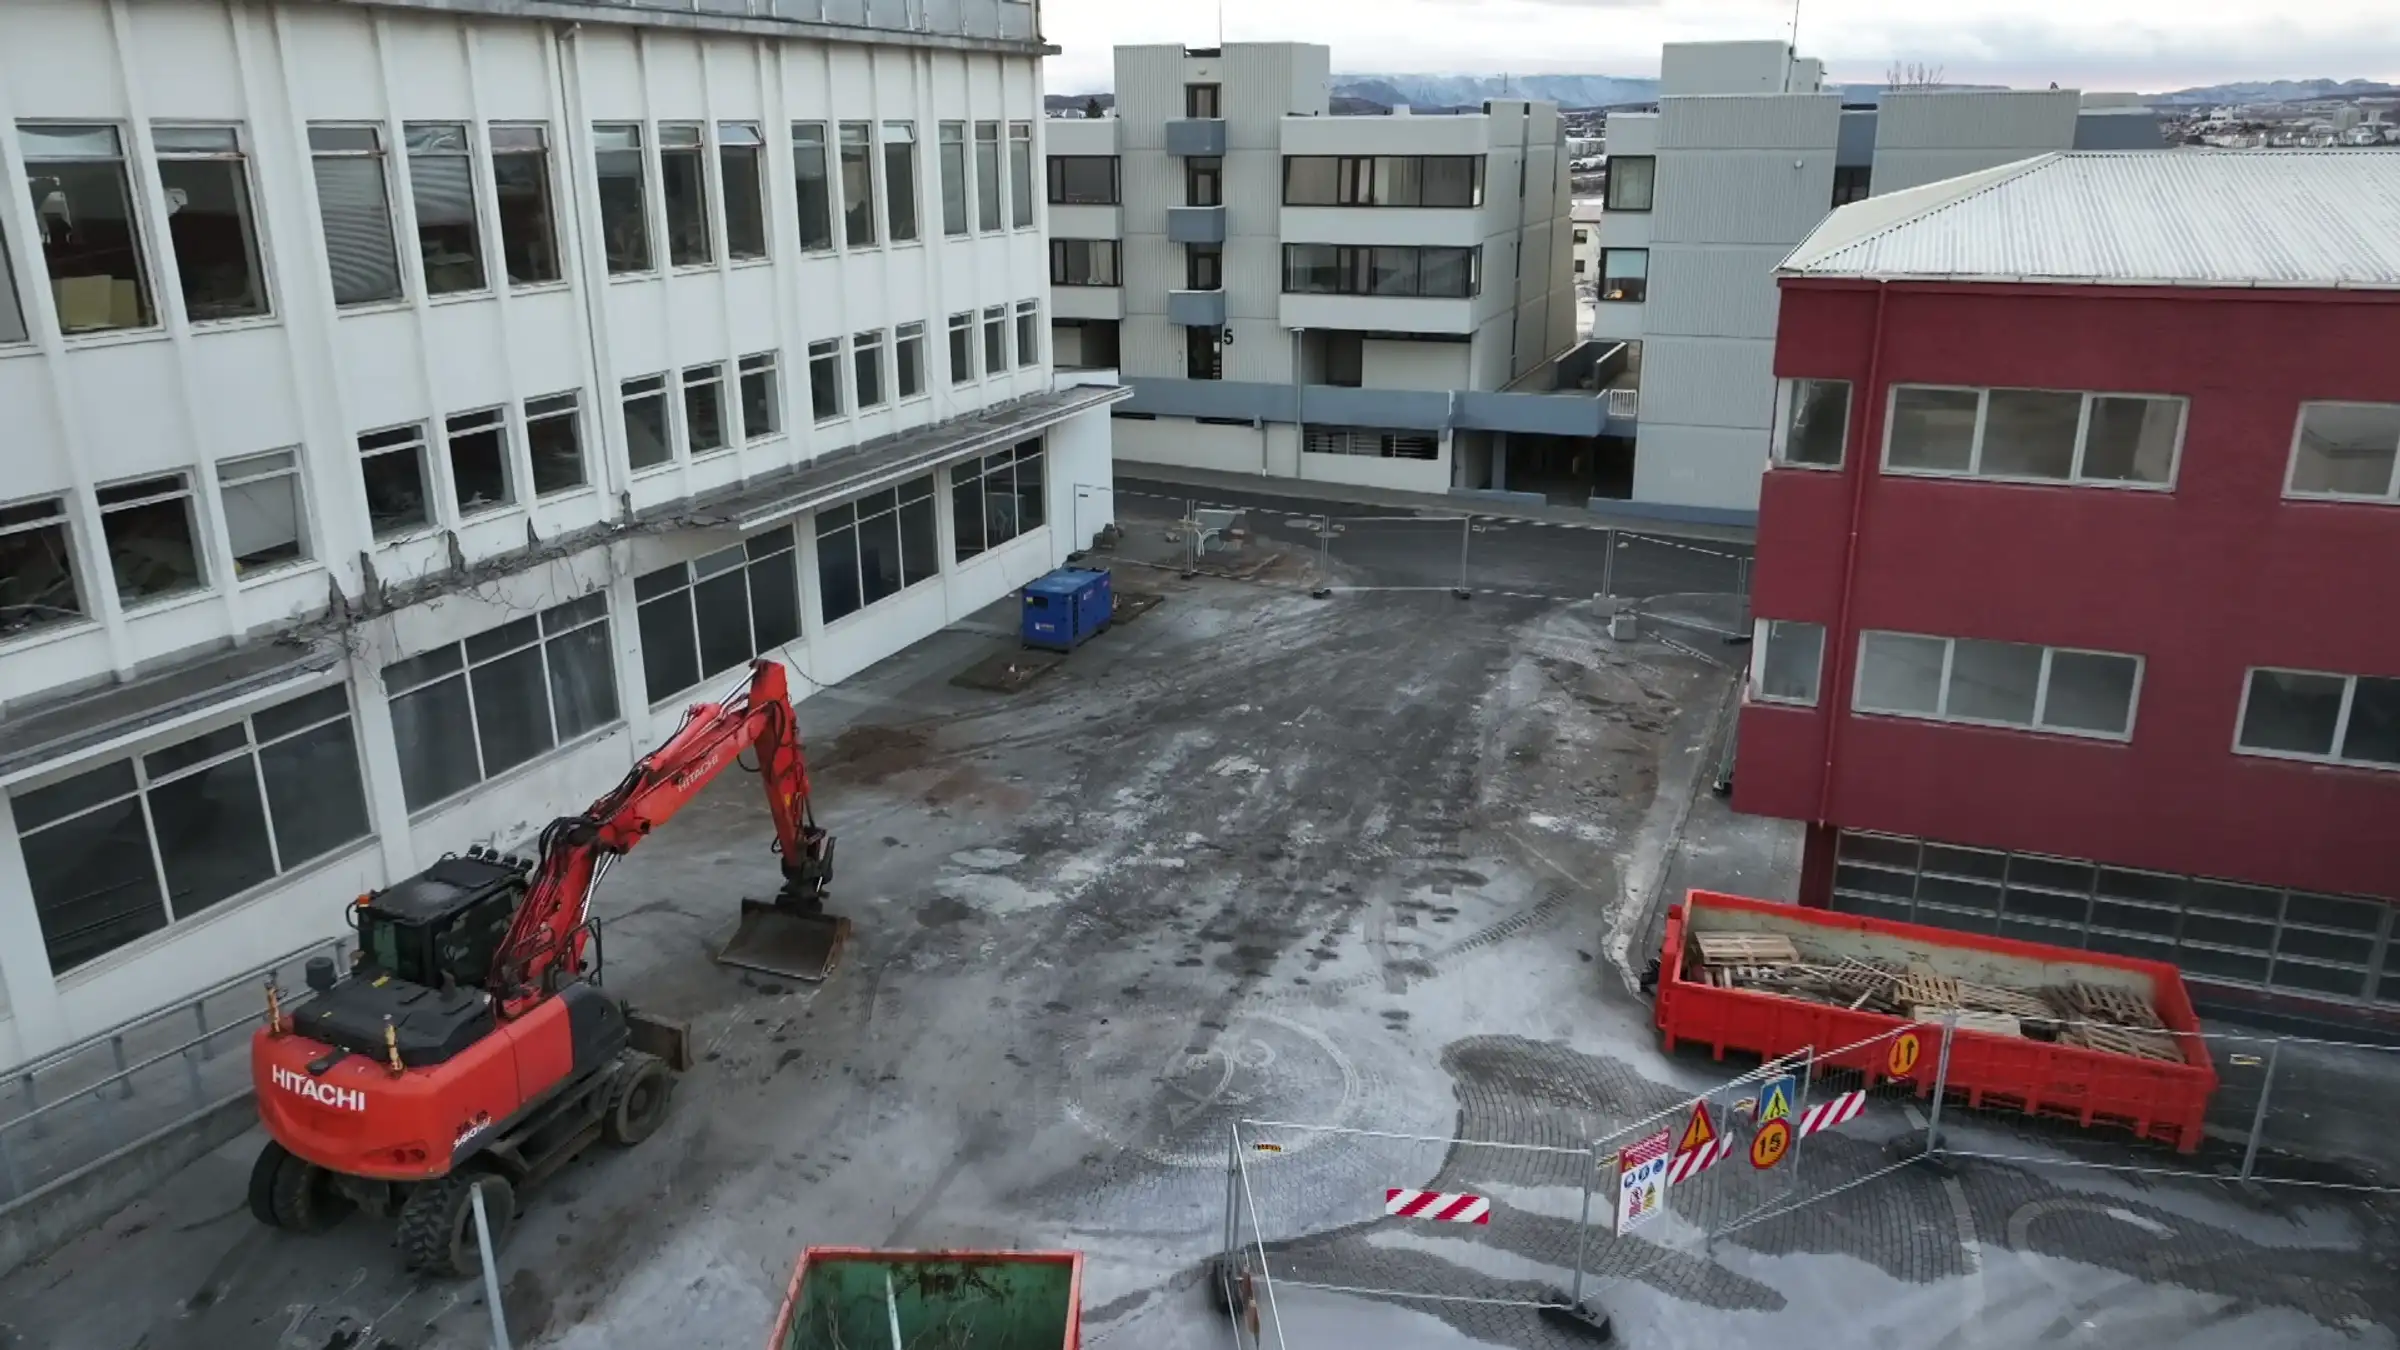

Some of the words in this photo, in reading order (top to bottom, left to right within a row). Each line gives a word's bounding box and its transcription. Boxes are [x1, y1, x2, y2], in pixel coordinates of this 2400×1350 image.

[1223, 328, 1234, 345] 5
[677, 754, 719, 792] HITACHI
[272, 1064, 365, 1112] HITACHI
